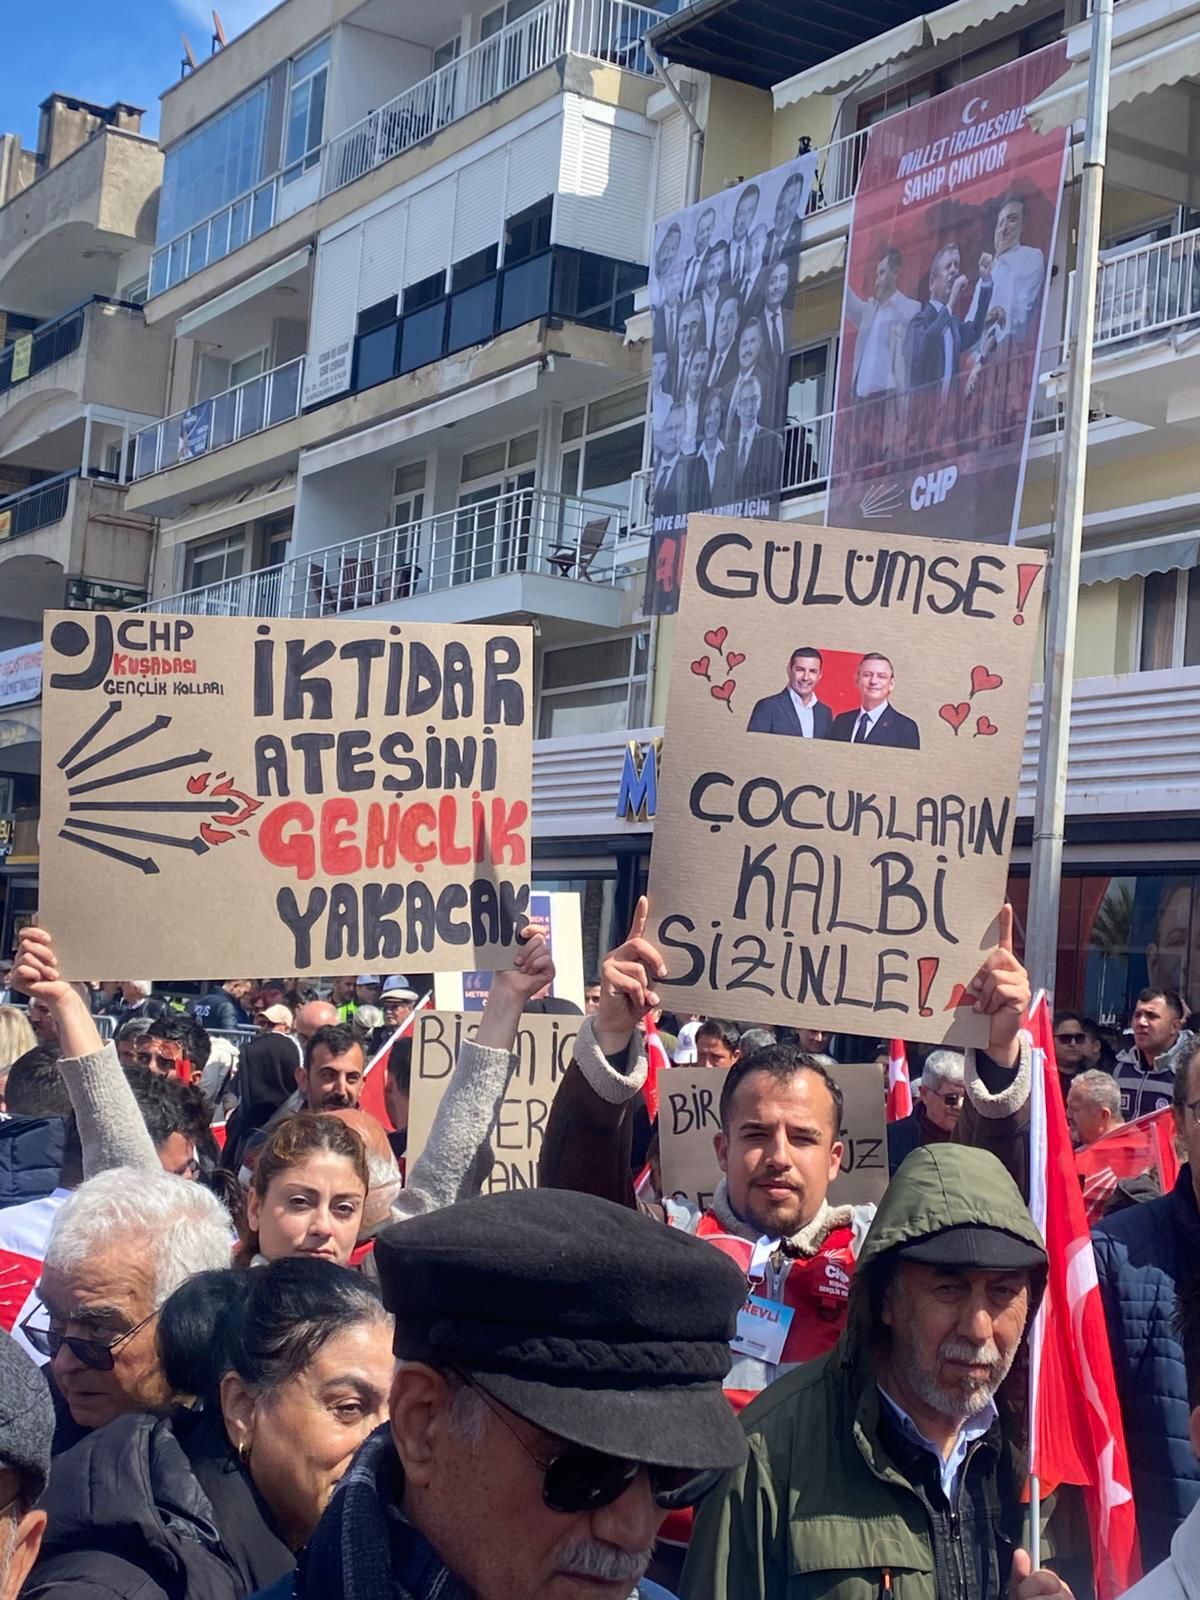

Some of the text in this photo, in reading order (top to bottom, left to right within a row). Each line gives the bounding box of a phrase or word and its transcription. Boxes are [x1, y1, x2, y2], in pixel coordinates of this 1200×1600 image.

[896, 136, 950, 180] MİLLET
[902, 140, 1008, 206] SAHİP ÇIKIYOR
[910, 464, 958, 511] CHP
[113, 653, 197, 679] KUŞADASI
[117, 619, 194, 652] CHP
[103, 678, 225, 697] GENÇLİK KOLLARI
[252, 624, 525, 727] İKTİDAR
[254, 725, 498, 800] ATEŞİNİ
[258, 790, 529, 880] GENÇLİK
[689, 772, 1010, 859] ÇOCUKLARIN
[276, 879, 531, 969] YAKACAK
[732, 843, 960, 945] KALBİ
[669, 1084, 722, 1136] BİR
